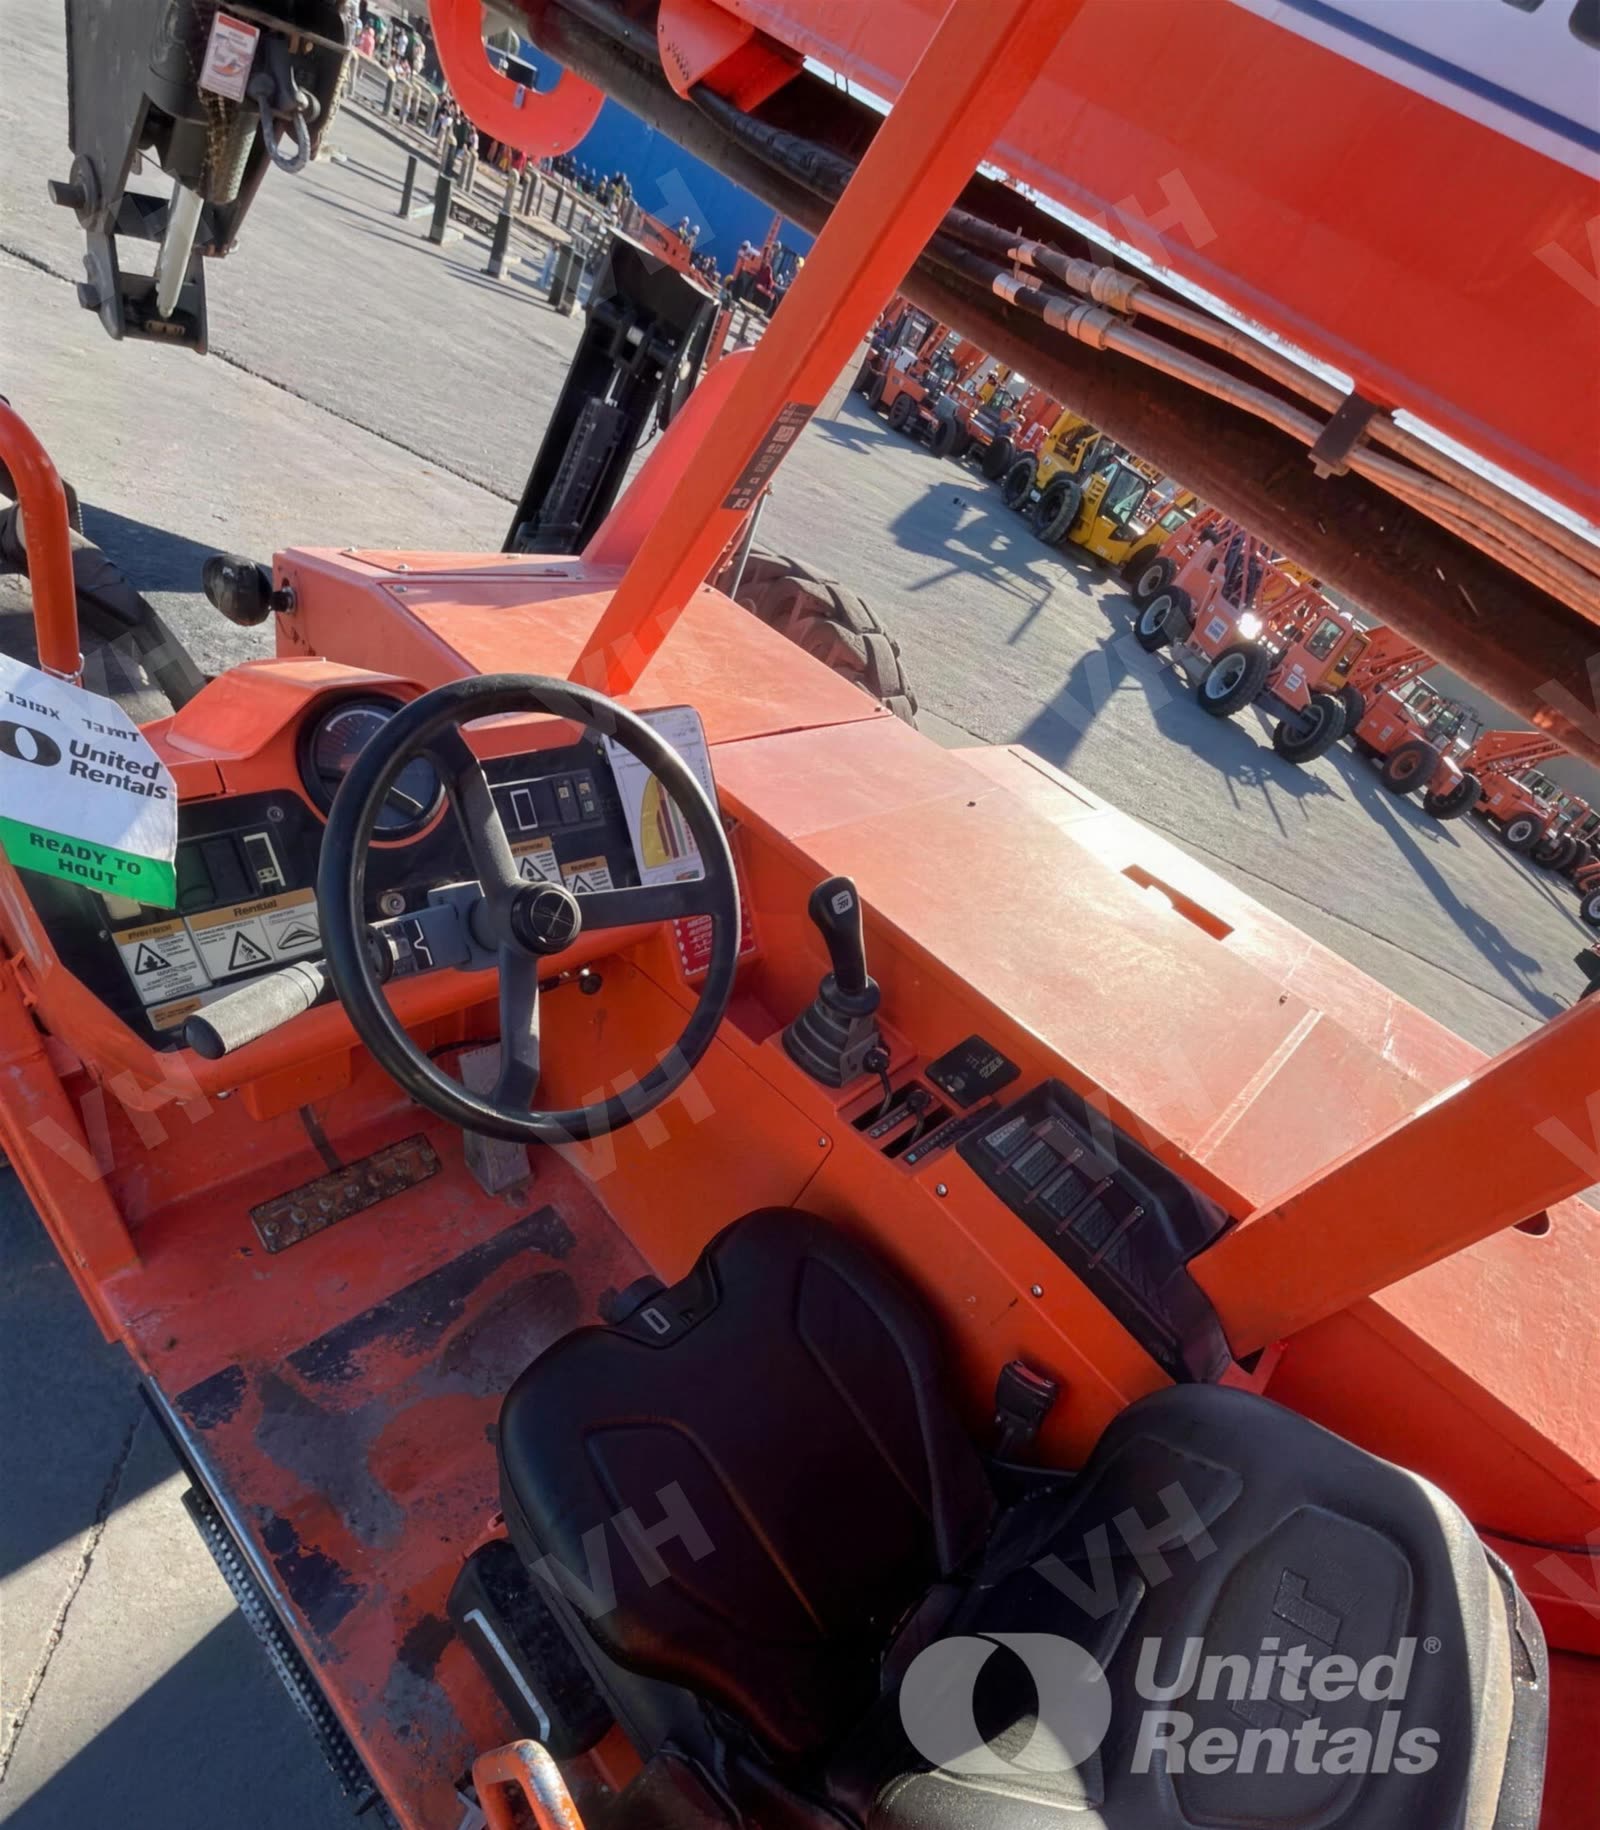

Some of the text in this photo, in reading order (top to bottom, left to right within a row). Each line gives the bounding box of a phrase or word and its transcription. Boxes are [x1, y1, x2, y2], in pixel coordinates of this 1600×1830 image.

[69, 740, 161, 779] United
[69, 760, 168, 800] Rentals
[114, 857, 141, 875] TO
